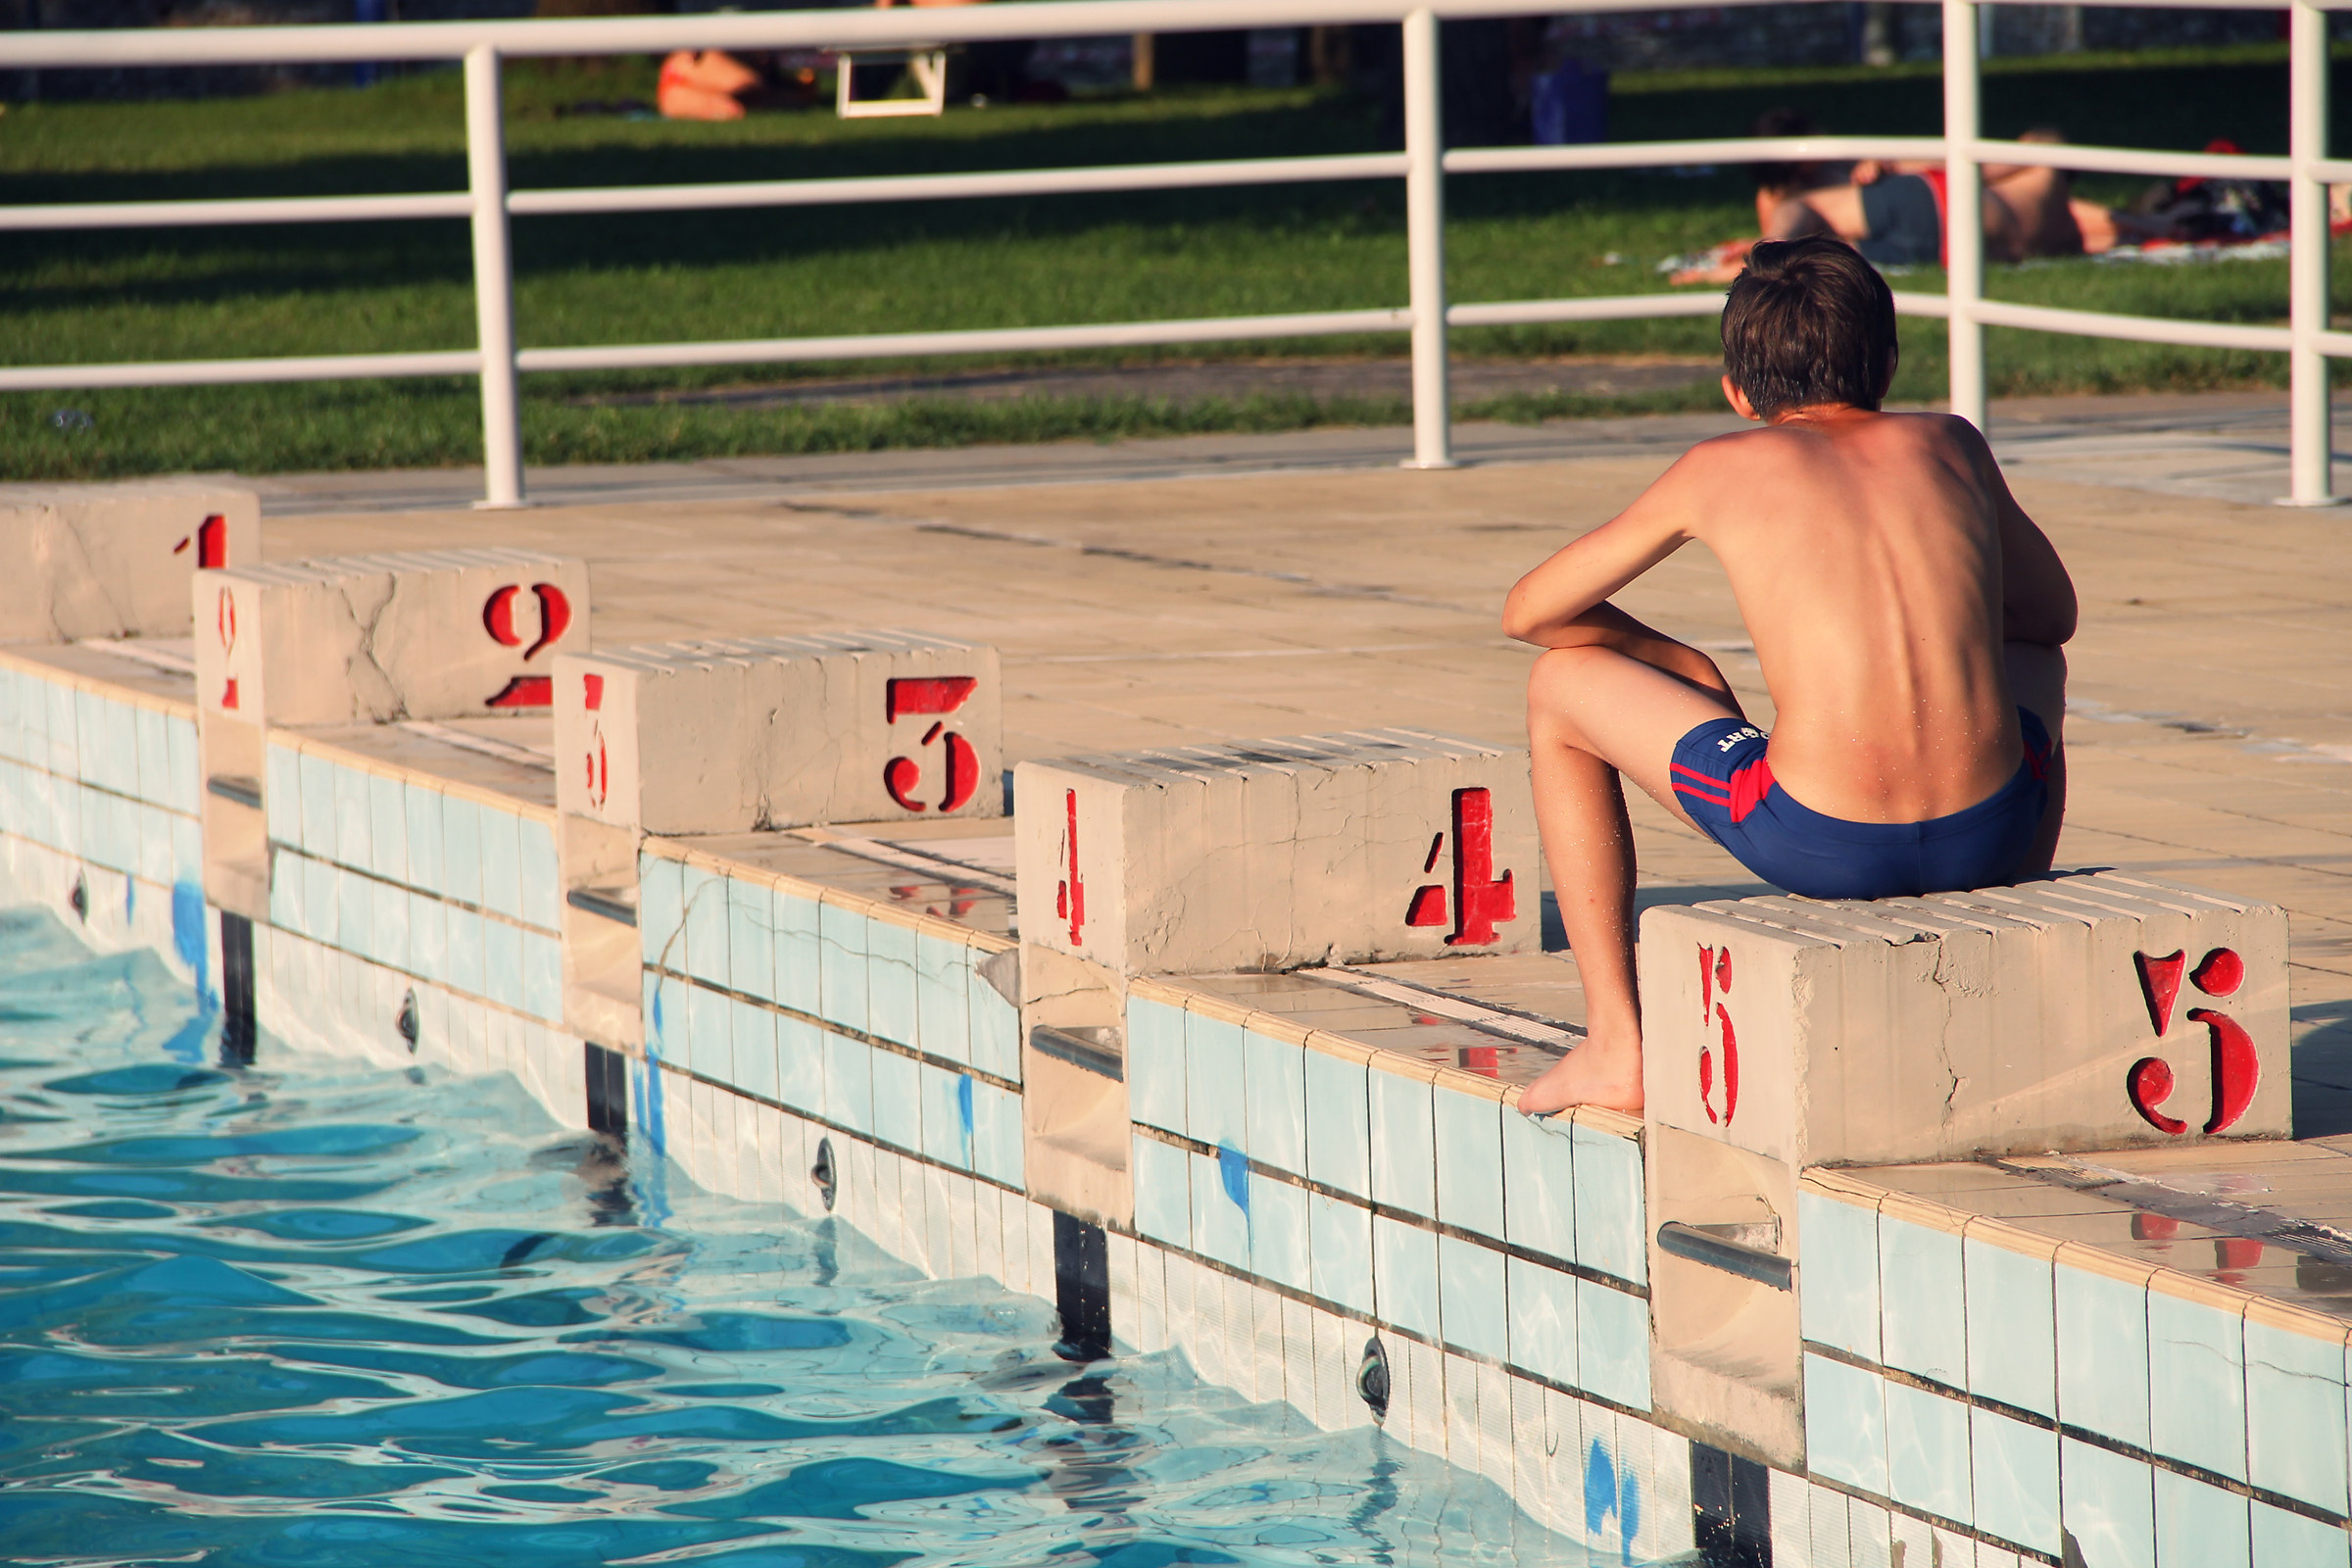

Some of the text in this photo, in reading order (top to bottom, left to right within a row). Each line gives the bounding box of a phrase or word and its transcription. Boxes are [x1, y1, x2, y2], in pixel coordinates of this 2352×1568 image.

[483, 583, 572, 708] 2
[884, 676, 981, 813] 3
[1056, 788, 1086, 947] 4
[1404, 786, 1518, 947] 4
[1696, 943, 1740, 1128] 5
[2127, 947, 2260, 1136] 5
